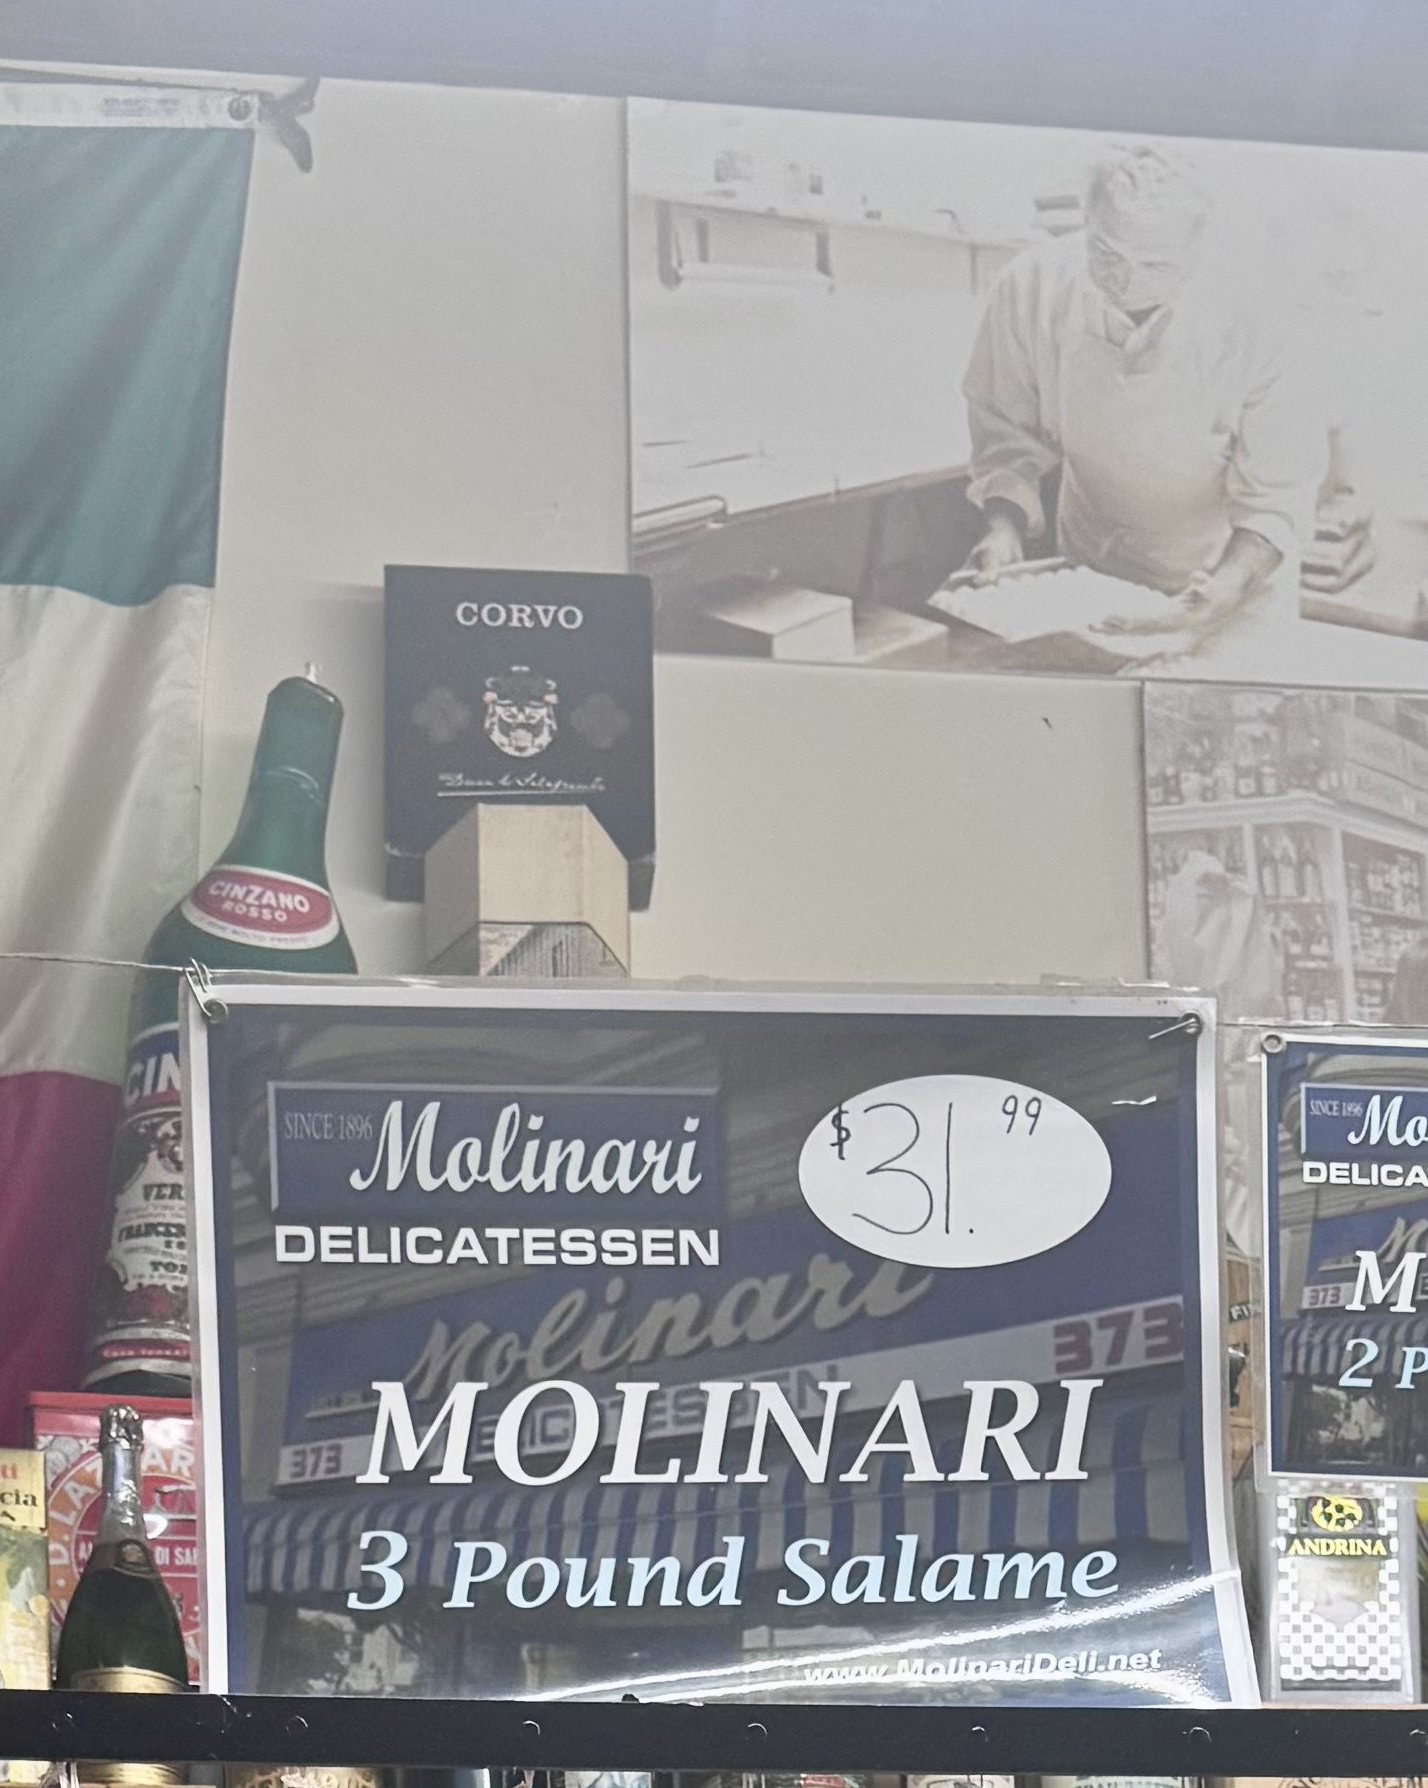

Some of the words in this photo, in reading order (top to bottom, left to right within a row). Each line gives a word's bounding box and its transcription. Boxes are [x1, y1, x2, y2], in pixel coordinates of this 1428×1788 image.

[456, 602, 583, 630] CORVO
[209, 881, 310, 913] CINZANO
[222, 901, 287, 922] ROSSO
[284, 1110, 331, 1140] SINCE
[1309, 1100, 1339, 1116] SINCE
[349, 1099, 702, 1195] Molinari
[275, 1225, 720, 1266] DELICATESSEN
[405, 1263, 936, 1399] Molinari
[1339, 1338, 1376, 1388] 2
[356, 1379, 1103, 1485] MOLINARI
[1288, 1537, 1387, 1557] ANDRINA
[347, 1530, 403, 1612] 3
[445, 1536, 745, 1609] Pound
[776, 1534, 1119, 1604] Salame
